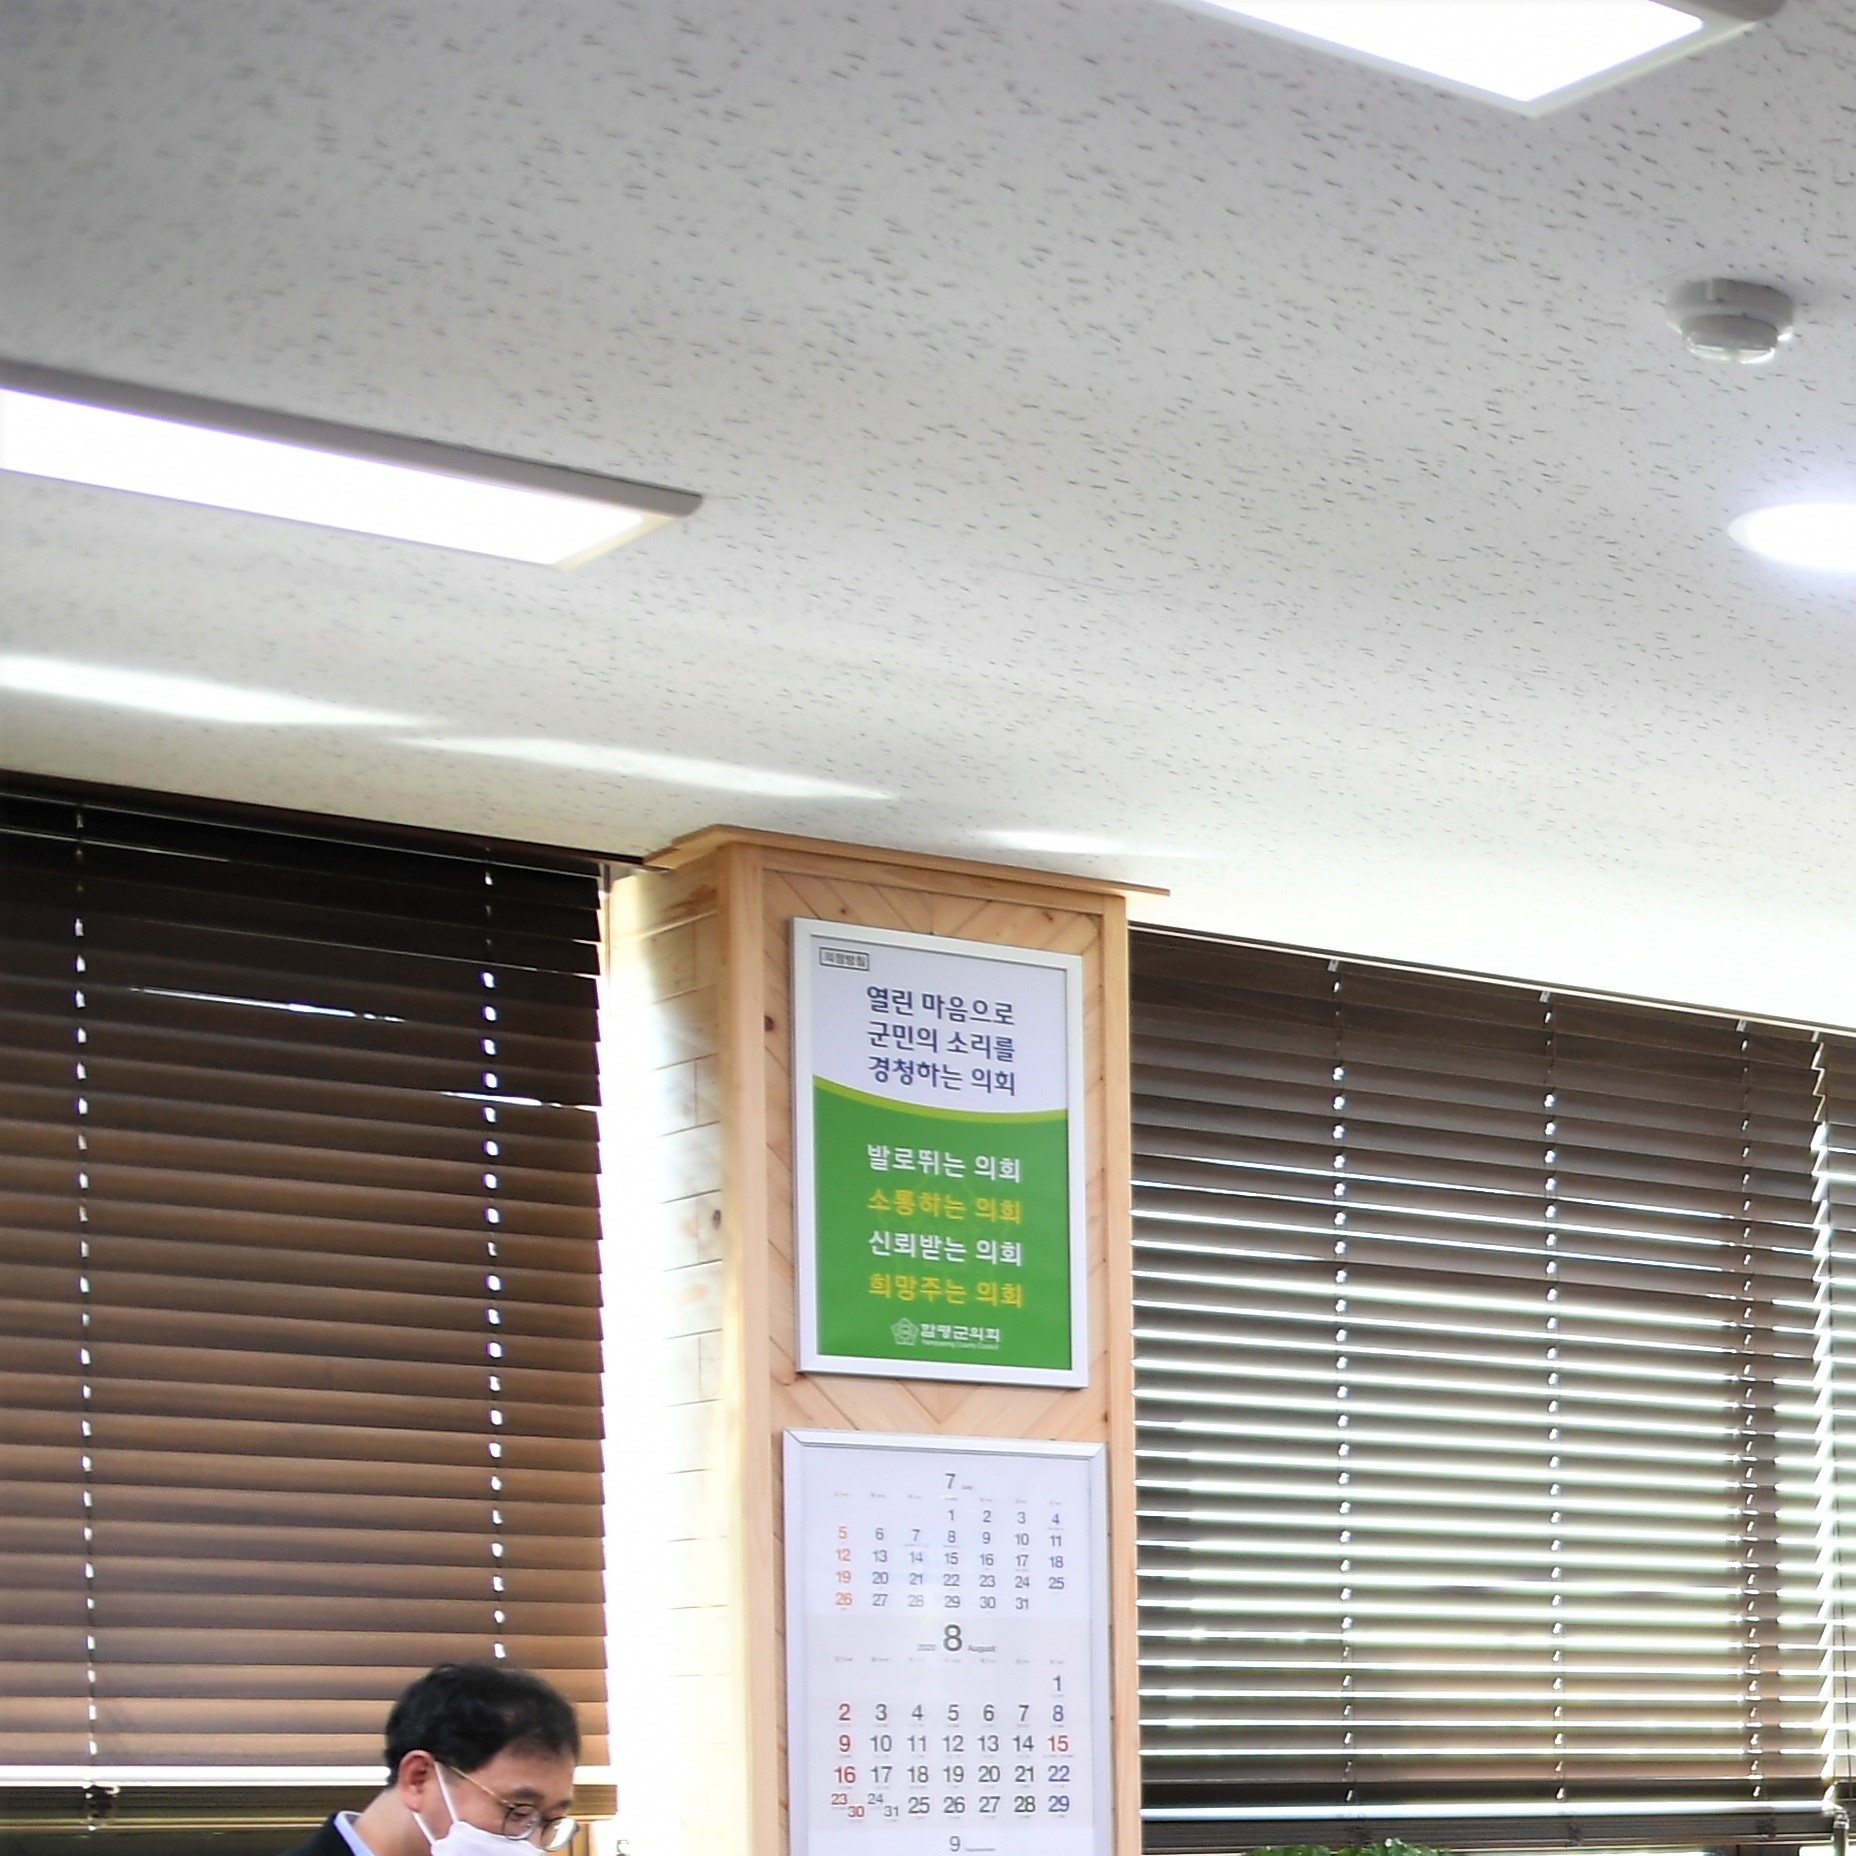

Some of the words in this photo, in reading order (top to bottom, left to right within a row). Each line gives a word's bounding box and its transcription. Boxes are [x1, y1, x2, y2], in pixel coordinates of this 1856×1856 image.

[866, 985, 914, 1017] 열린
[921, 992, 1015, 1026] 마음으로
[866, 1020, 938, 1054] 군민의
[946, 1031, 1015, 1063] 소리를
[868, 1055, 963, 1091] 경청하는
[971, 1067, 1015, 1097] 의회
[866, 1143, 966, 1179] 발로뛰는
[973, 1155, 1021, 1184] 의회
[866, 1188, 967, 1221] 소통하는
[974, 1197, 1021, 1225] 의회
[868, 1230, 968, 1263] 신뢰받는
[975, 1239, 1022, 1267] 의회
[868, 1272, 968, 1305] 희망주는
[975, 1281, 1022, 1309] 의회
[944, 1472, 957, 1490] 7
[982, 1509, 992, 1524] 2
[1017, 1511, 1027, 1525] 3
[1051, 1513, 1061, 1526] 4
[838, 1525, 848, 1540] 5
[875, 1527, 885, 1541] 6
[911, 1528, 921, 1542] 7
[947, 1529, 957, 1544] 8
[982, 1531, 991, 1545] 9
[1014, 1532, 1030, 1546] 10
[1049, 1534, 1062, 1547] 11
[835, 1548, 852, 1562] 12
[872, 1549, 888, 1563] 13
[909, 1551, 924, 1564] 14
[944, 1551, 959, 1566] 15
[979, 1553, 994, 1567] 16
[1015, 1553, 1030, 1568] 17
[1049, 1555, 1064, 1569] 18
[835, 1569, 852, 1584] 19
[871, 1570, 890, 1585] 20
[908, 1572, 924, 1586] 21
[943, 1573, 961, 1587] 22
[978, 1574, 996, 1588] 23
[1014, 1575, 1031, 1589] 24
[1048, 1576, 1065, 1590] 25
[835, 1591, 853, 1606] 26
[872, 1593, 889, 1607] 27
[944, 1595, 961, 1609] 29
[979, 1595, 997, 1610] 30
[1015, 1596, 1029, 1610] 31
[943, 1624, 963, 1652] 8
[838, 1703, 851, 1722] 2
[875, 1703, 888, 1722] 3
[911, 1704, 924, 1722] 4
[947, 1703, 960, 1722] 5
[983, 1704, 995, 1722] 6
[1018, 1704, 1030, 1722] 7
[1052, 1704, 1065, 1723] 8
[839, 1734, 851, 1753] 9
[869, 1734, 893, 1753] 10
[906, 1734, 927, 1752] 11
[942, 1734, 965, 1753] 12
[977, 1734, 1000, 1753] 13
[1012, 1735, 1035, 1752] 14
[1047, 1734, 1069, 1753] 15
[834, 1765, 857, 1784] 16
[870, 1765, 893, 1784] 17
[906, 1765, 930, 1784] 18
[942, 1765, 965, 1783] 19
[977, 1765, 1001, 1783] 20
[1014, 1765, 1035, 1783] 21
[1047, 1764, 1071, 1783] 22
[830, 1792, 848, 1806] 23
[847, 1805, 865, 1818] 30
[867, 1792, 884, 1804] 24
[883, 1805, 899, 1818] 31
[907, 1796, 931, 1814] 25
[943, 1795, 966, 1814] 26
[978, 1795, 1001, 1814] 27
[1013, 1795, 1036, 1813] 28
[1047, 1795, 1070, 1813] 29
[949, 1835, 961, 1853] 9
